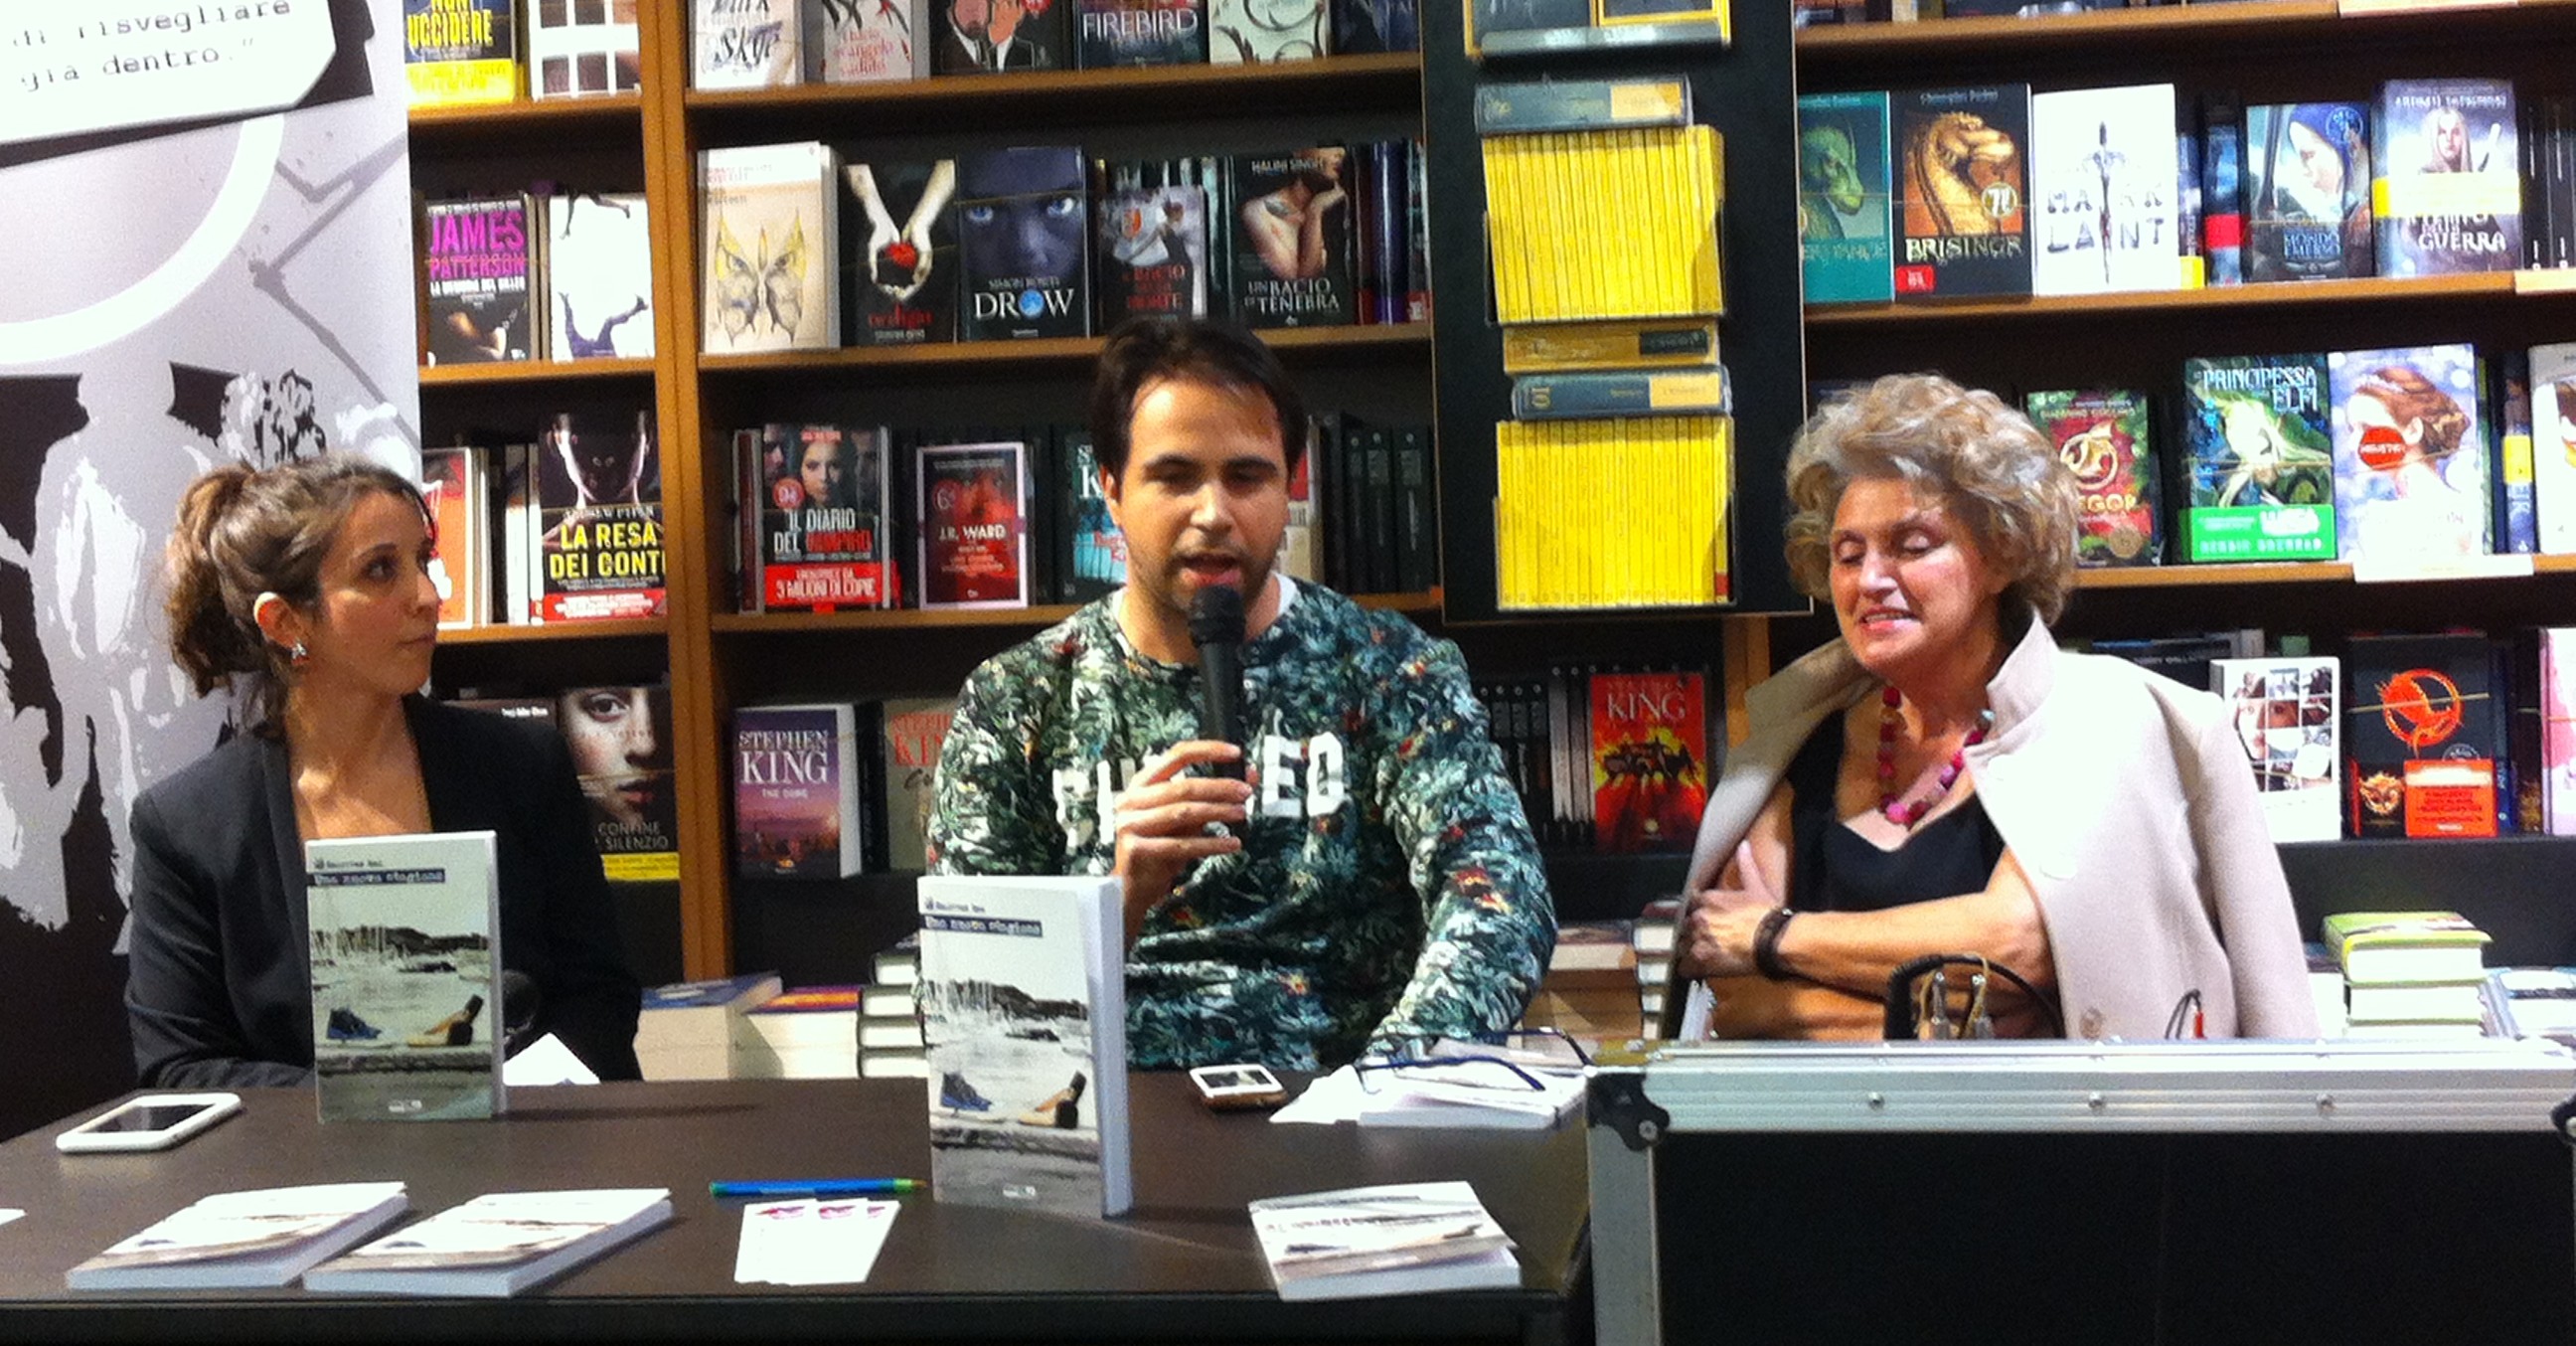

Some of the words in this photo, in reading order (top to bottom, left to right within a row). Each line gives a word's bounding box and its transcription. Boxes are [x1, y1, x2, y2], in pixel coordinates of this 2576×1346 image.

[78, 0, 291, 39] risvegliare
[406, 9, 493, 48] UCCIDERE
[1081, 8, 1199, 42] FIREBIRD
[429, 209, 525, 255] JAMES
[2418, 230, 2507, 254] GUERRA
[429, 252, 526, 279] PATTERSON
[1270, 276, 1332, 296] BACIO
[974, 288, 1074, 320] DROW
[1256, 293, 1340, 315] TENEBRA
[2203, 366, 2318, 391] PRINCIPESSA
[788, 509, 802, 532] IL
[806, 507, 856, 531] DIARIO
[962, 524, 1007, 541] WARD
[561, 523, 589, 550] LA
[596, 522, 657, 549] RESA
[773, 531, 801, 554] DEL
[549, 553, 589, 580] DEI
[1606, 690, 1687, 721] KING
[738, 730, 829, 750] STEPHEN
[738, 750, 829, 784] KING
[597, 821, 660, 836] CONFINE
[605, 835, 669, 850] SILENZIO
